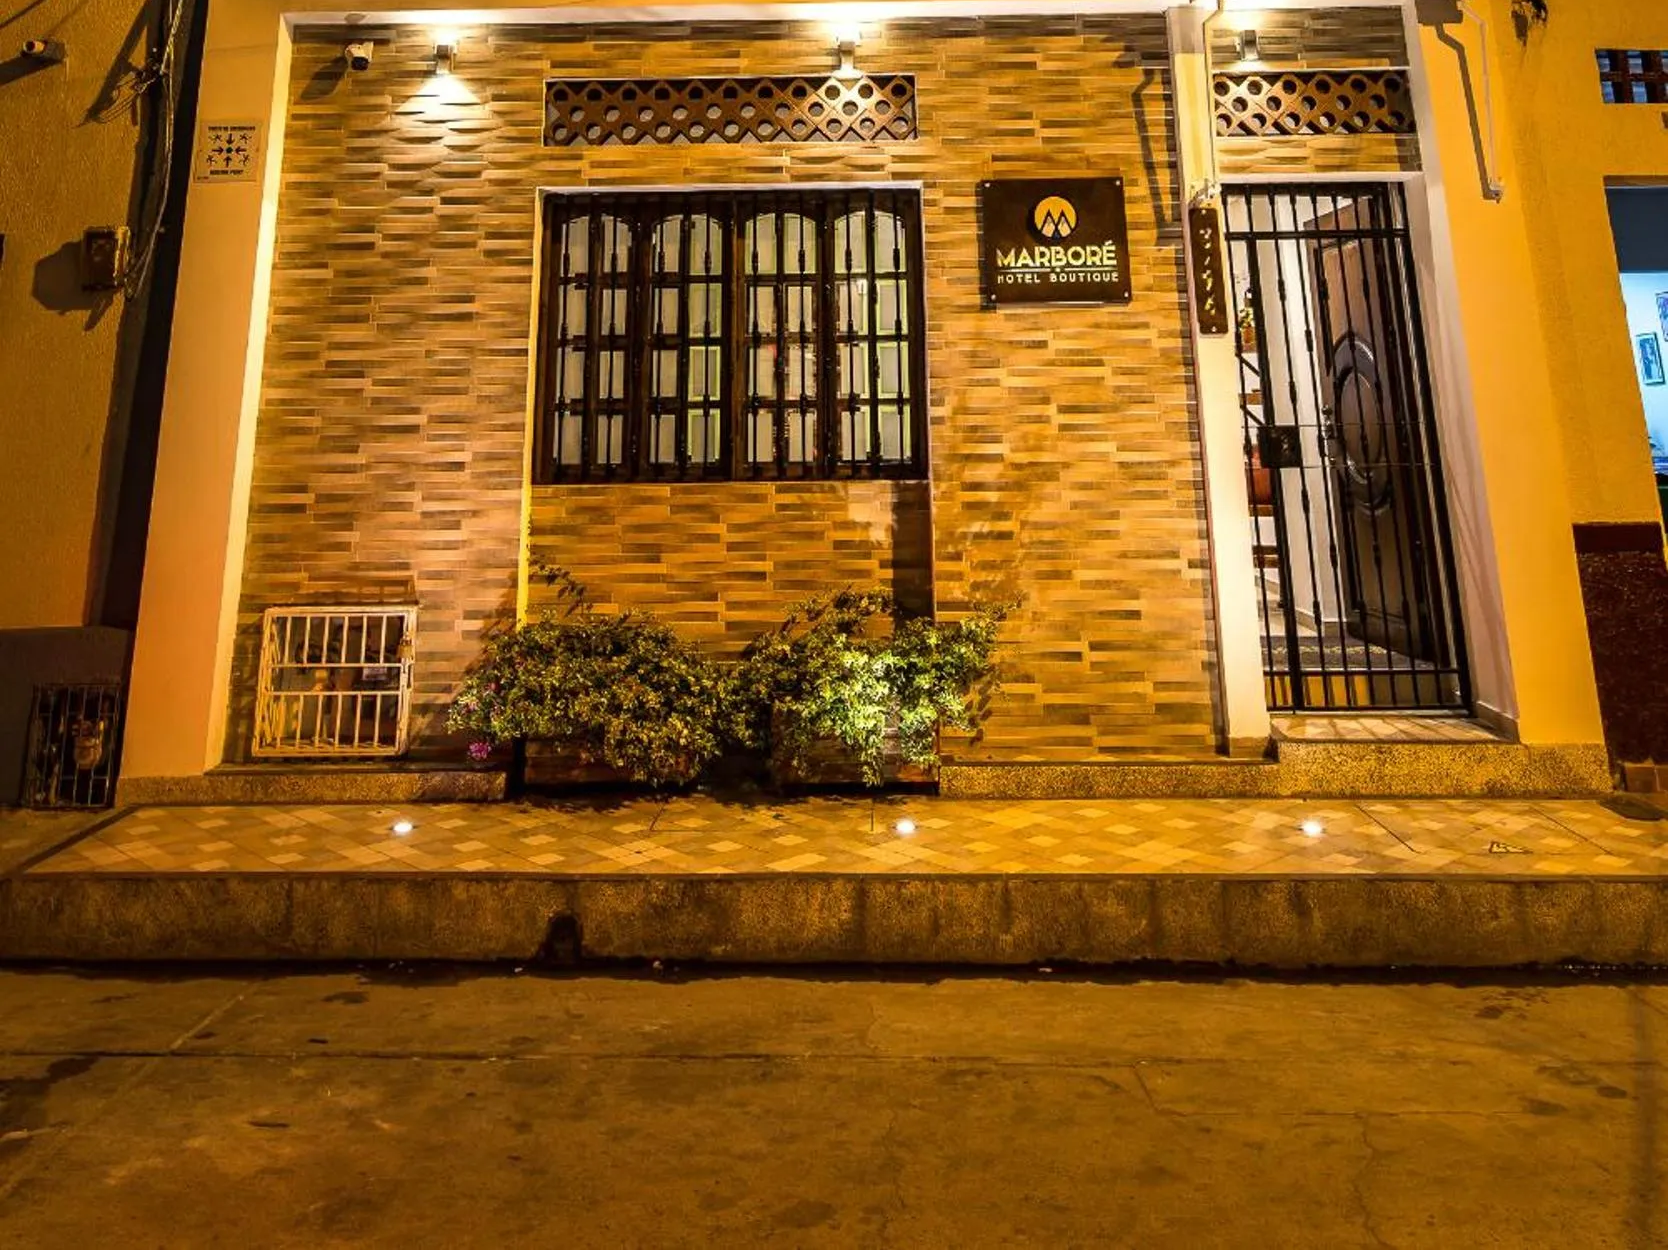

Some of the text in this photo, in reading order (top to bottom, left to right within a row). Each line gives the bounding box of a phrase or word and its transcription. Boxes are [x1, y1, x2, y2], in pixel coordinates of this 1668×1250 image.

[996, 240, 1117, 267] MARBORÉ
[997, 272, 1119, 284] HOTEL BOUTIQUE
